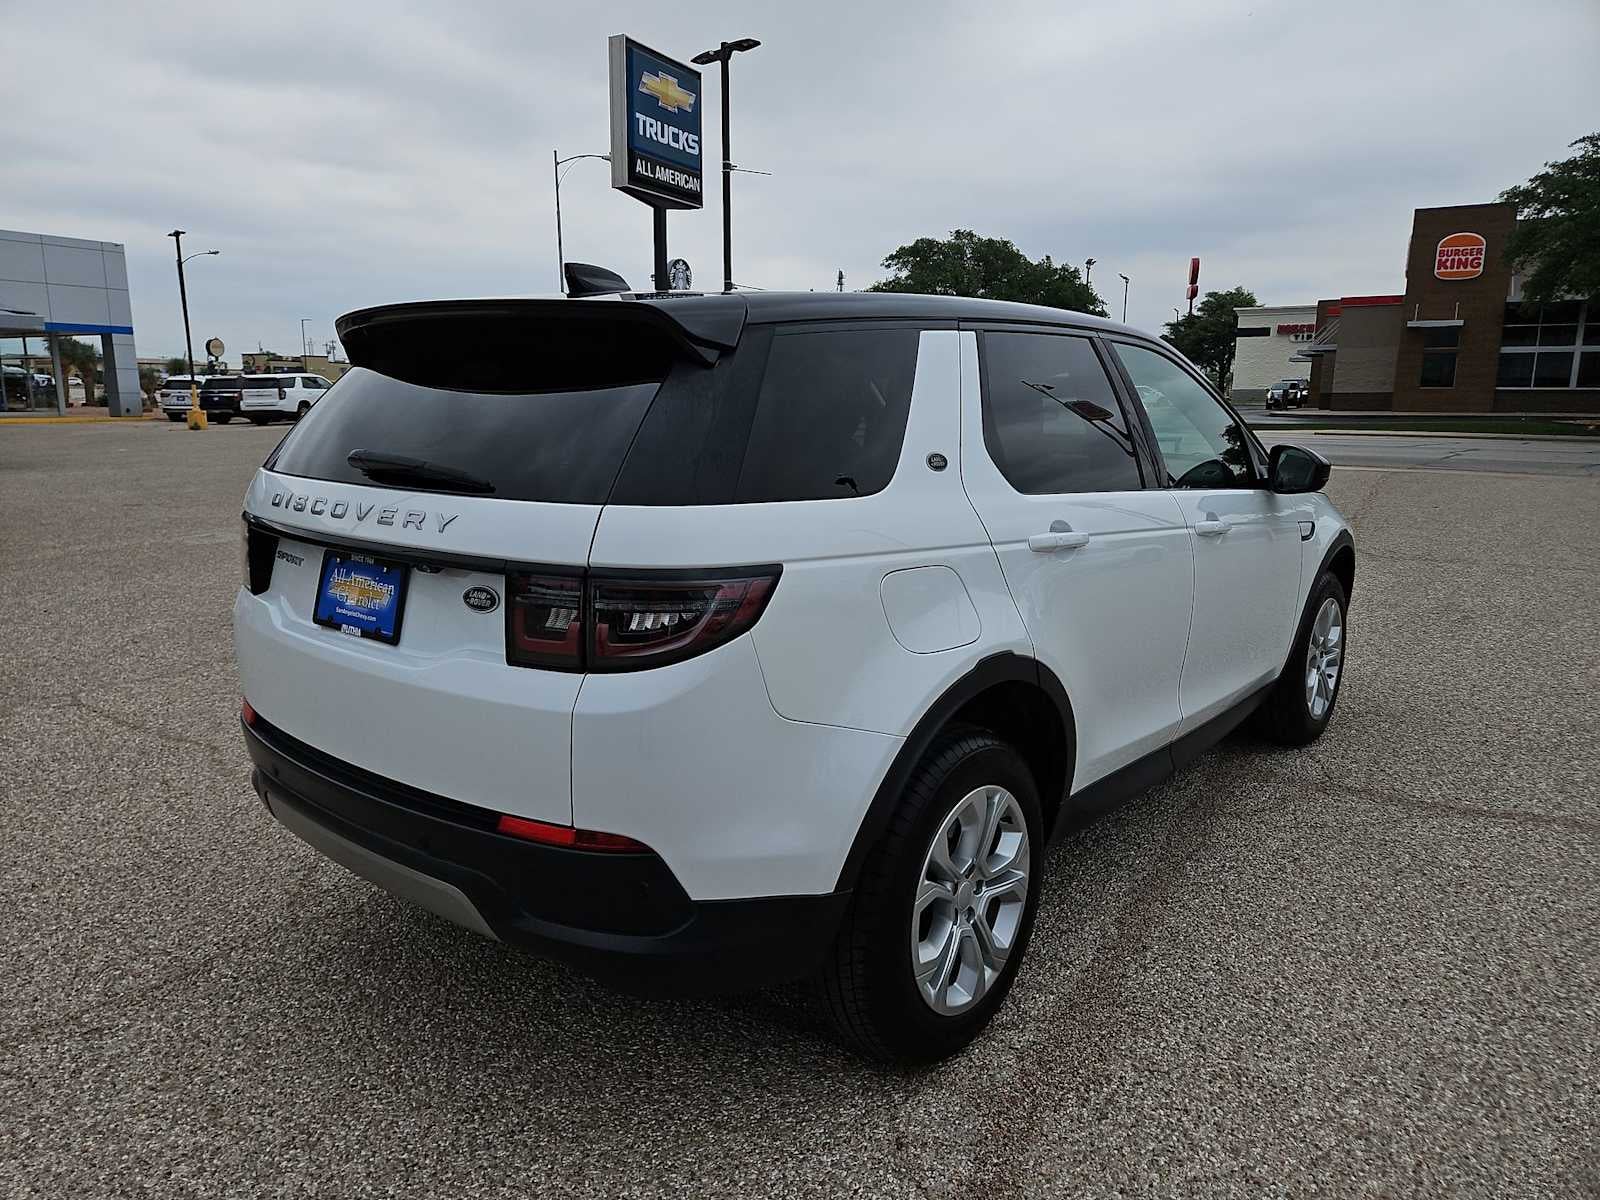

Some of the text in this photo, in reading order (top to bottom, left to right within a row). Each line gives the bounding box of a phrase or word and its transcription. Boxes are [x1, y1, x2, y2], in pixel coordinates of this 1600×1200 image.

[636, 112, 699, 155] TRUCKS
[636, 158, 700, 192] ALL AMERICAN
[1438, 248, 1484, 258] BURGER
[1436, 257, 1482, 270] KING
[271, 491, 460, 534] DISCOVERY
[277, 550, 305, 567] SPORT
[330, 567, 395, 596] All American
[469, 590, 487, 600] LAND
[470, 597, 492, 608] ROVER
